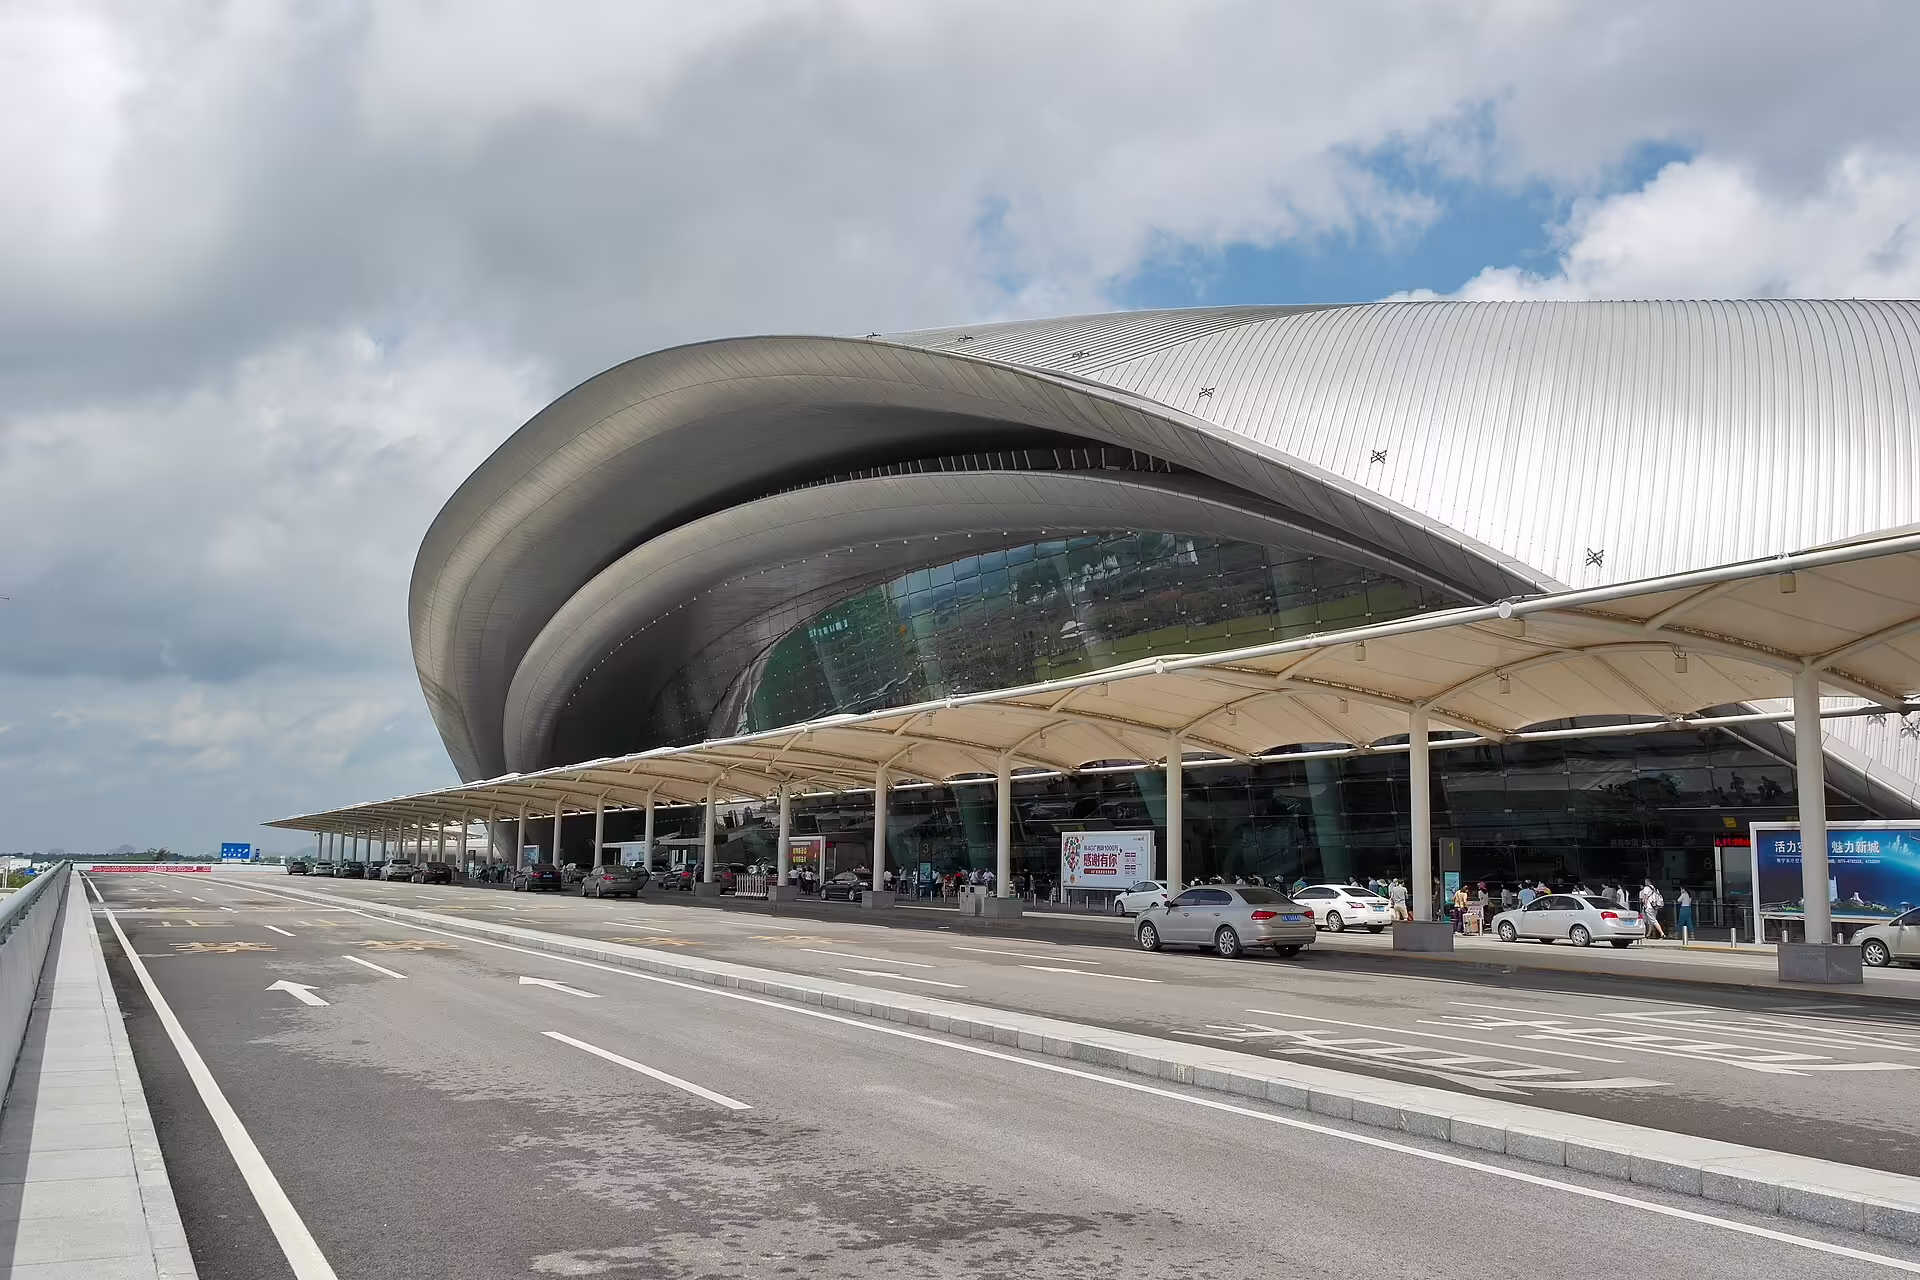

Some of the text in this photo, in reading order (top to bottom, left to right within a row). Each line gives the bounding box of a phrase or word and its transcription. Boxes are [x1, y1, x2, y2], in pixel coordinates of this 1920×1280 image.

[922, 843, 929, 853] 3
[1448, 841, 1454, 856] 1
[1831, 841, 1880, 853] 魅力新城
[1083, 853, 1118, 867] 感谢有你
[1415, 1015, 1920, 1077] 道
[1170, 1024, 1675, 1096] 道
